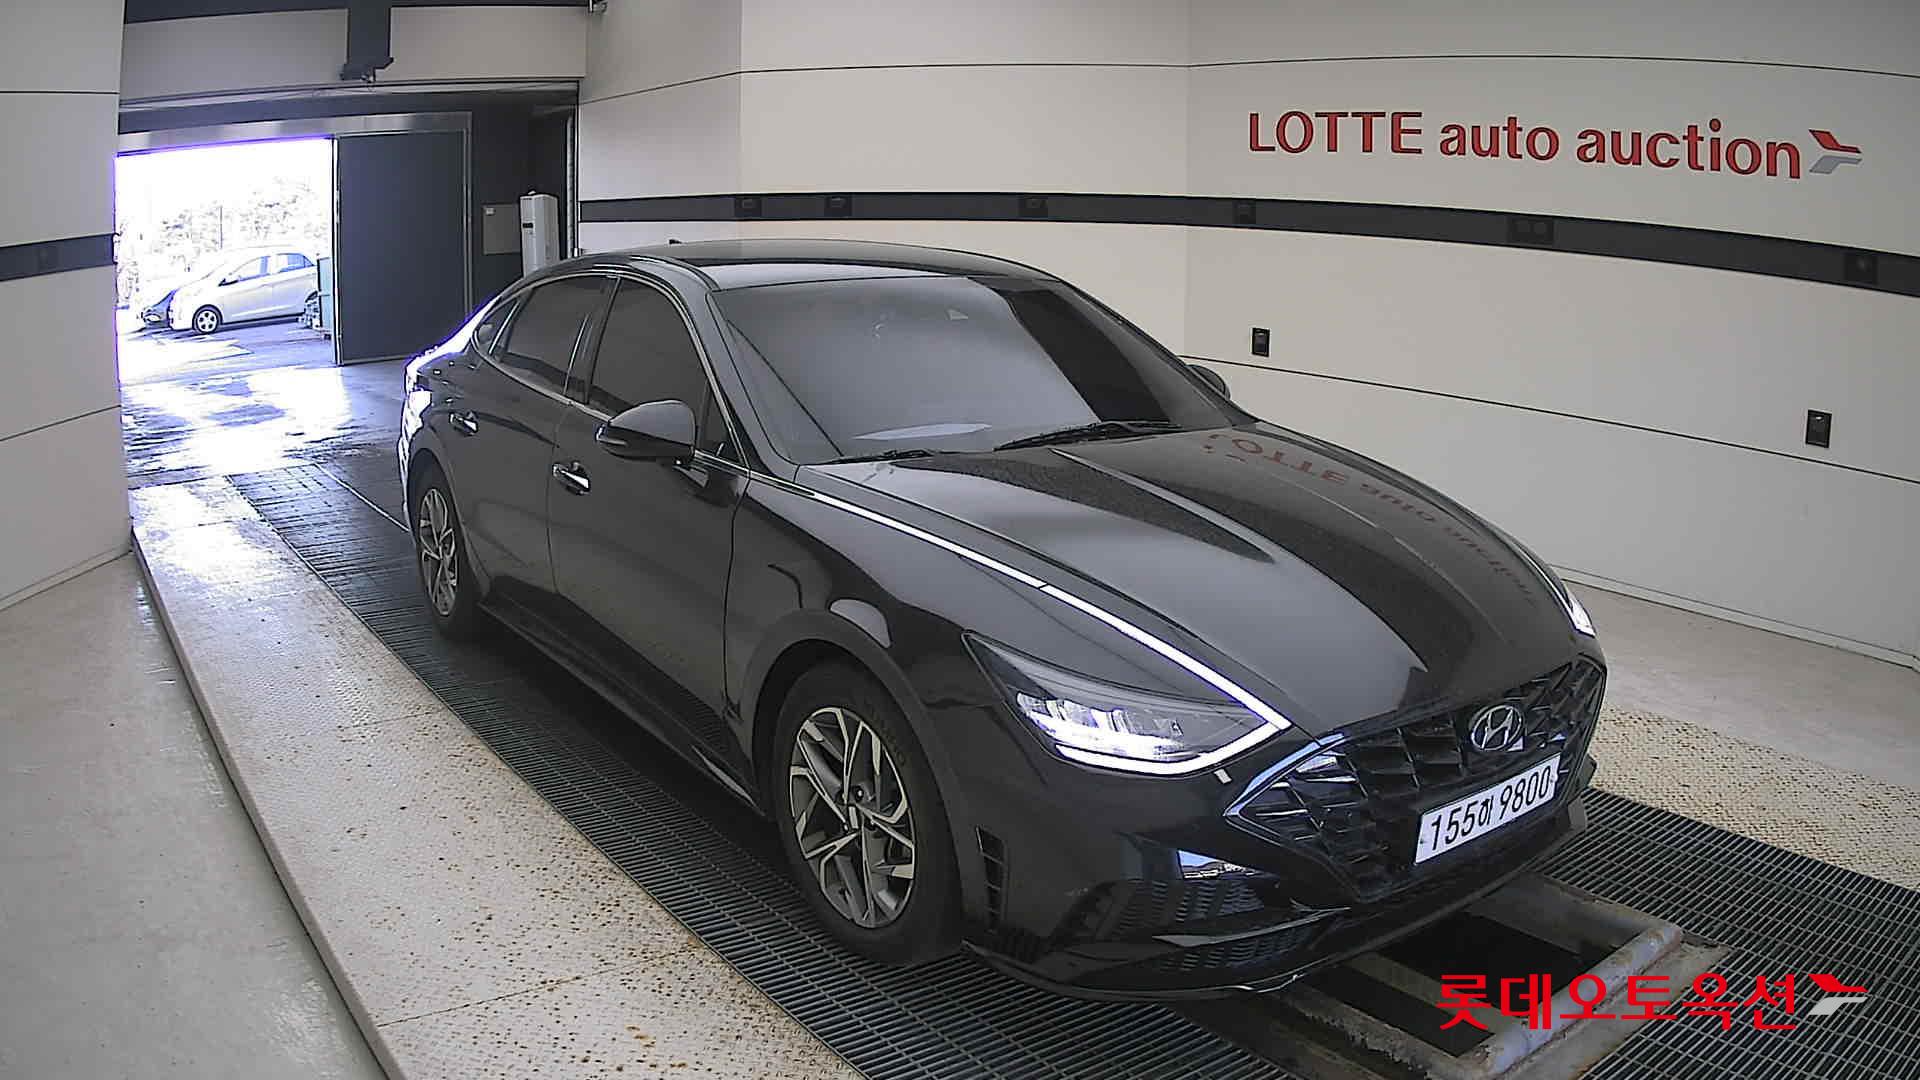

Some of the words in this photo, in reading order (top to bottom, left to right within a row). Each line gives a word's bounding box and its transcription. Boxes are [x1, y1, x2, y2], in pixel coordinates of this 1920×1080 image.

[1249, 111, 1423, 154] LOTTE
[1439, 116, 1560, 161] auto
[1576, 118, 1801, 179] auction
[1499, 765, 1551, 820] 9800
